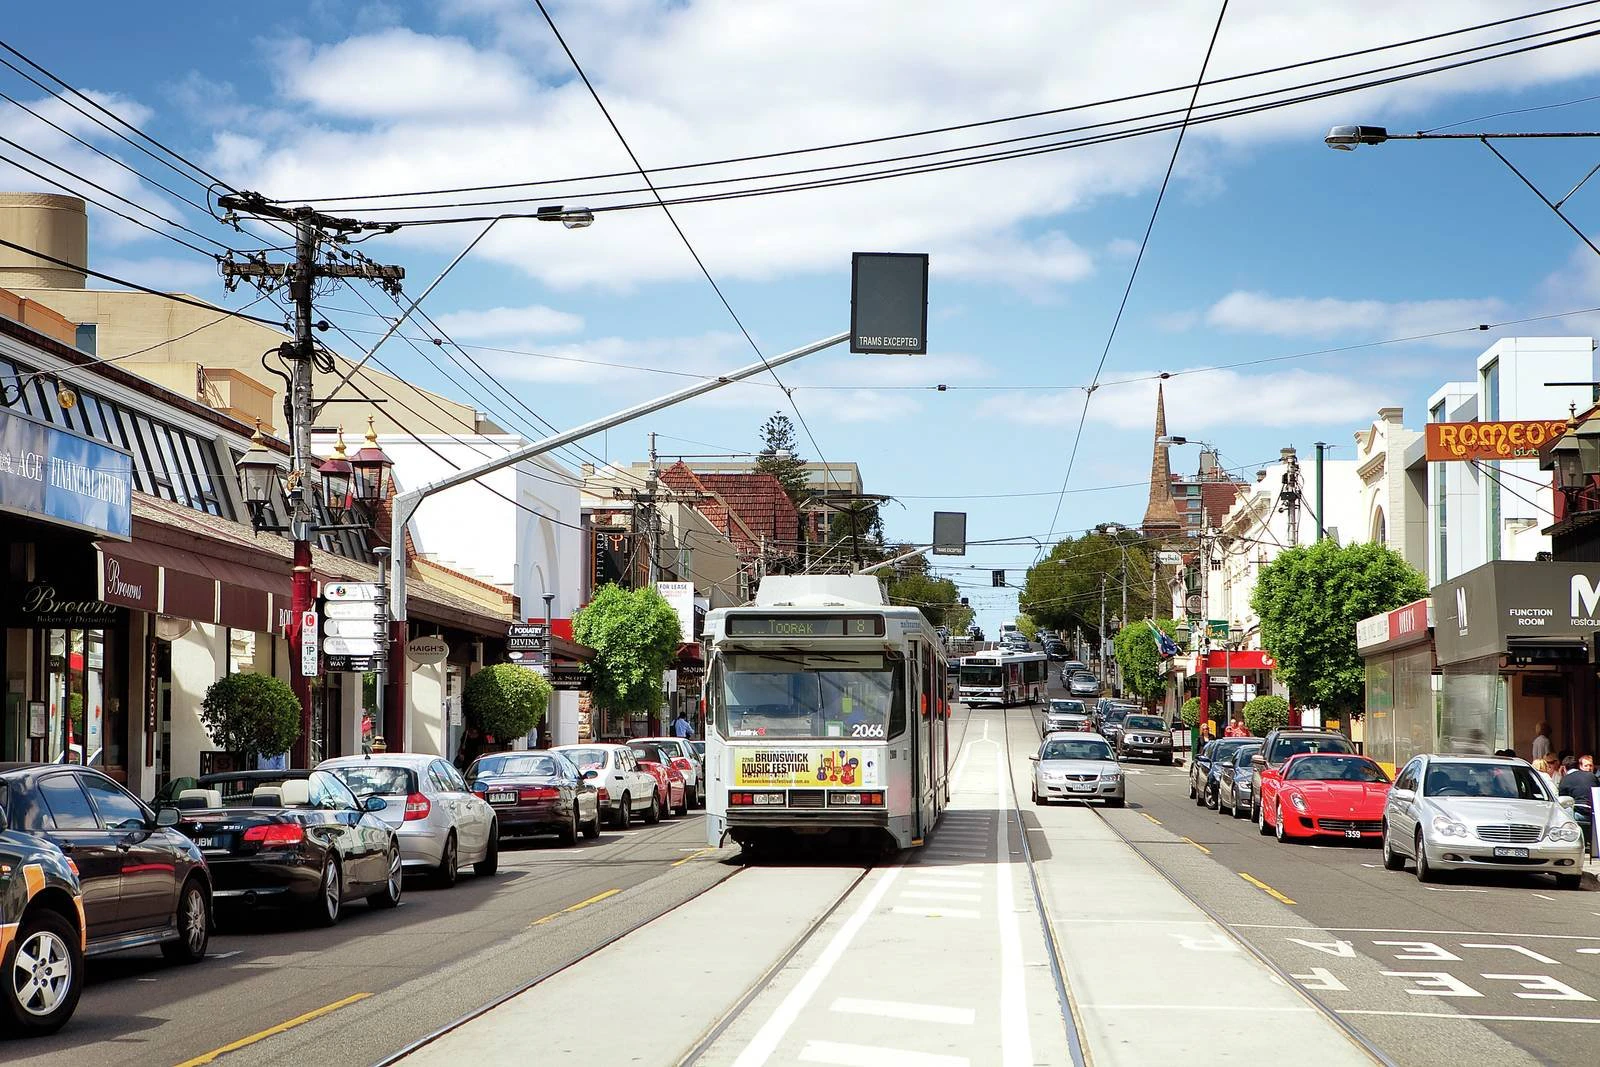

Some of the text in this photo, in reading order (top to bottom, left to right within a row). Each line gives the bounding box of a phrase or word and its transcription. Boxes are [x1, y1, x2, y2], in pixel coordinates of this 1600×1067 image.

[859, 336, 918, 347] TRAMS EXCEPTED
[17, 449, 43, 481] AGE
[51, 456, 126, 507] FINANCIAL REVIEW
[107, 557, 142, 600] Browns
[22, 585, 117, 613] Browns
[1509, 608, 1553, 616] FUNCTION
[856, 619, 865, 632] 8
[1518, 618, 1545, 626] ROOM
[515, 627, 542, 635] PODIATRY
[511, 638, 540, 646] DIVINA
[306, 646, 315, 656] 1P
[852, 724, 884, 738] 2066
[755, 753, 809, 762] BRUNSWICK
[742, 763, 810, 773] MUSIC FESTIVAL
